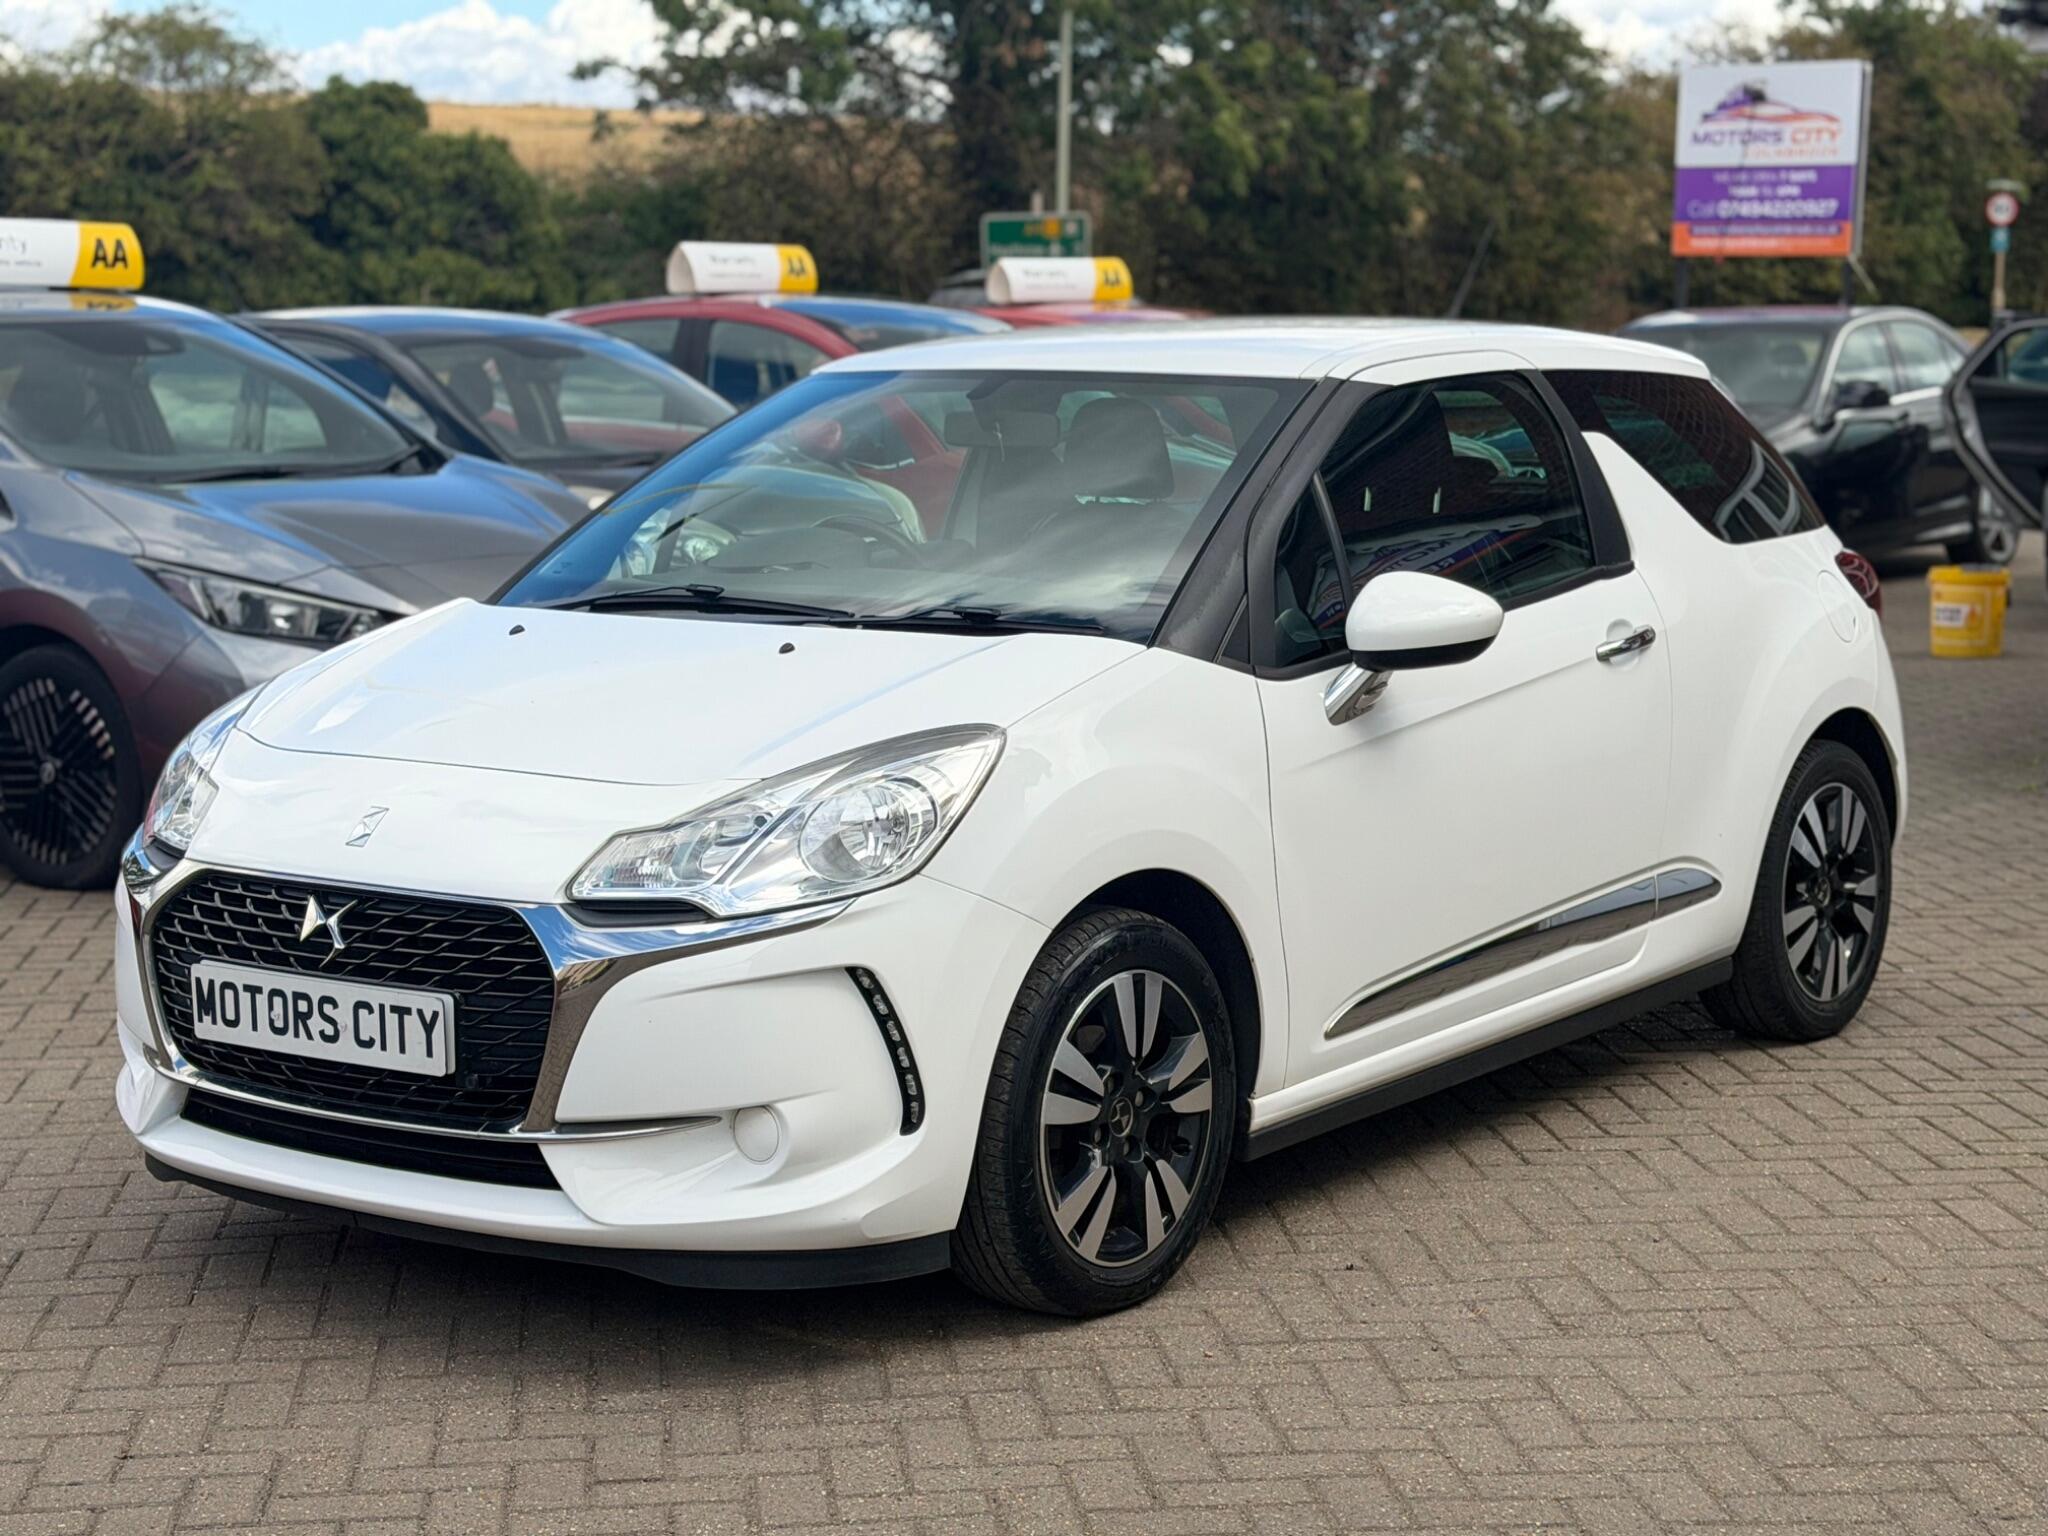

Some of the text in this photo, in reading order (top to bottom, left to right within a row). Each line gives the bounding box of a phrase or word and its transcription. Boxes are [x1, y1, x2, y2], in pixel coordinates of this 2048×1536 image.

[1691, 127, 1842, 146] MOTORS CITY
[91, 238, 128, 269] AA
[195, 977, 440, 1059] MOTORS CITY
